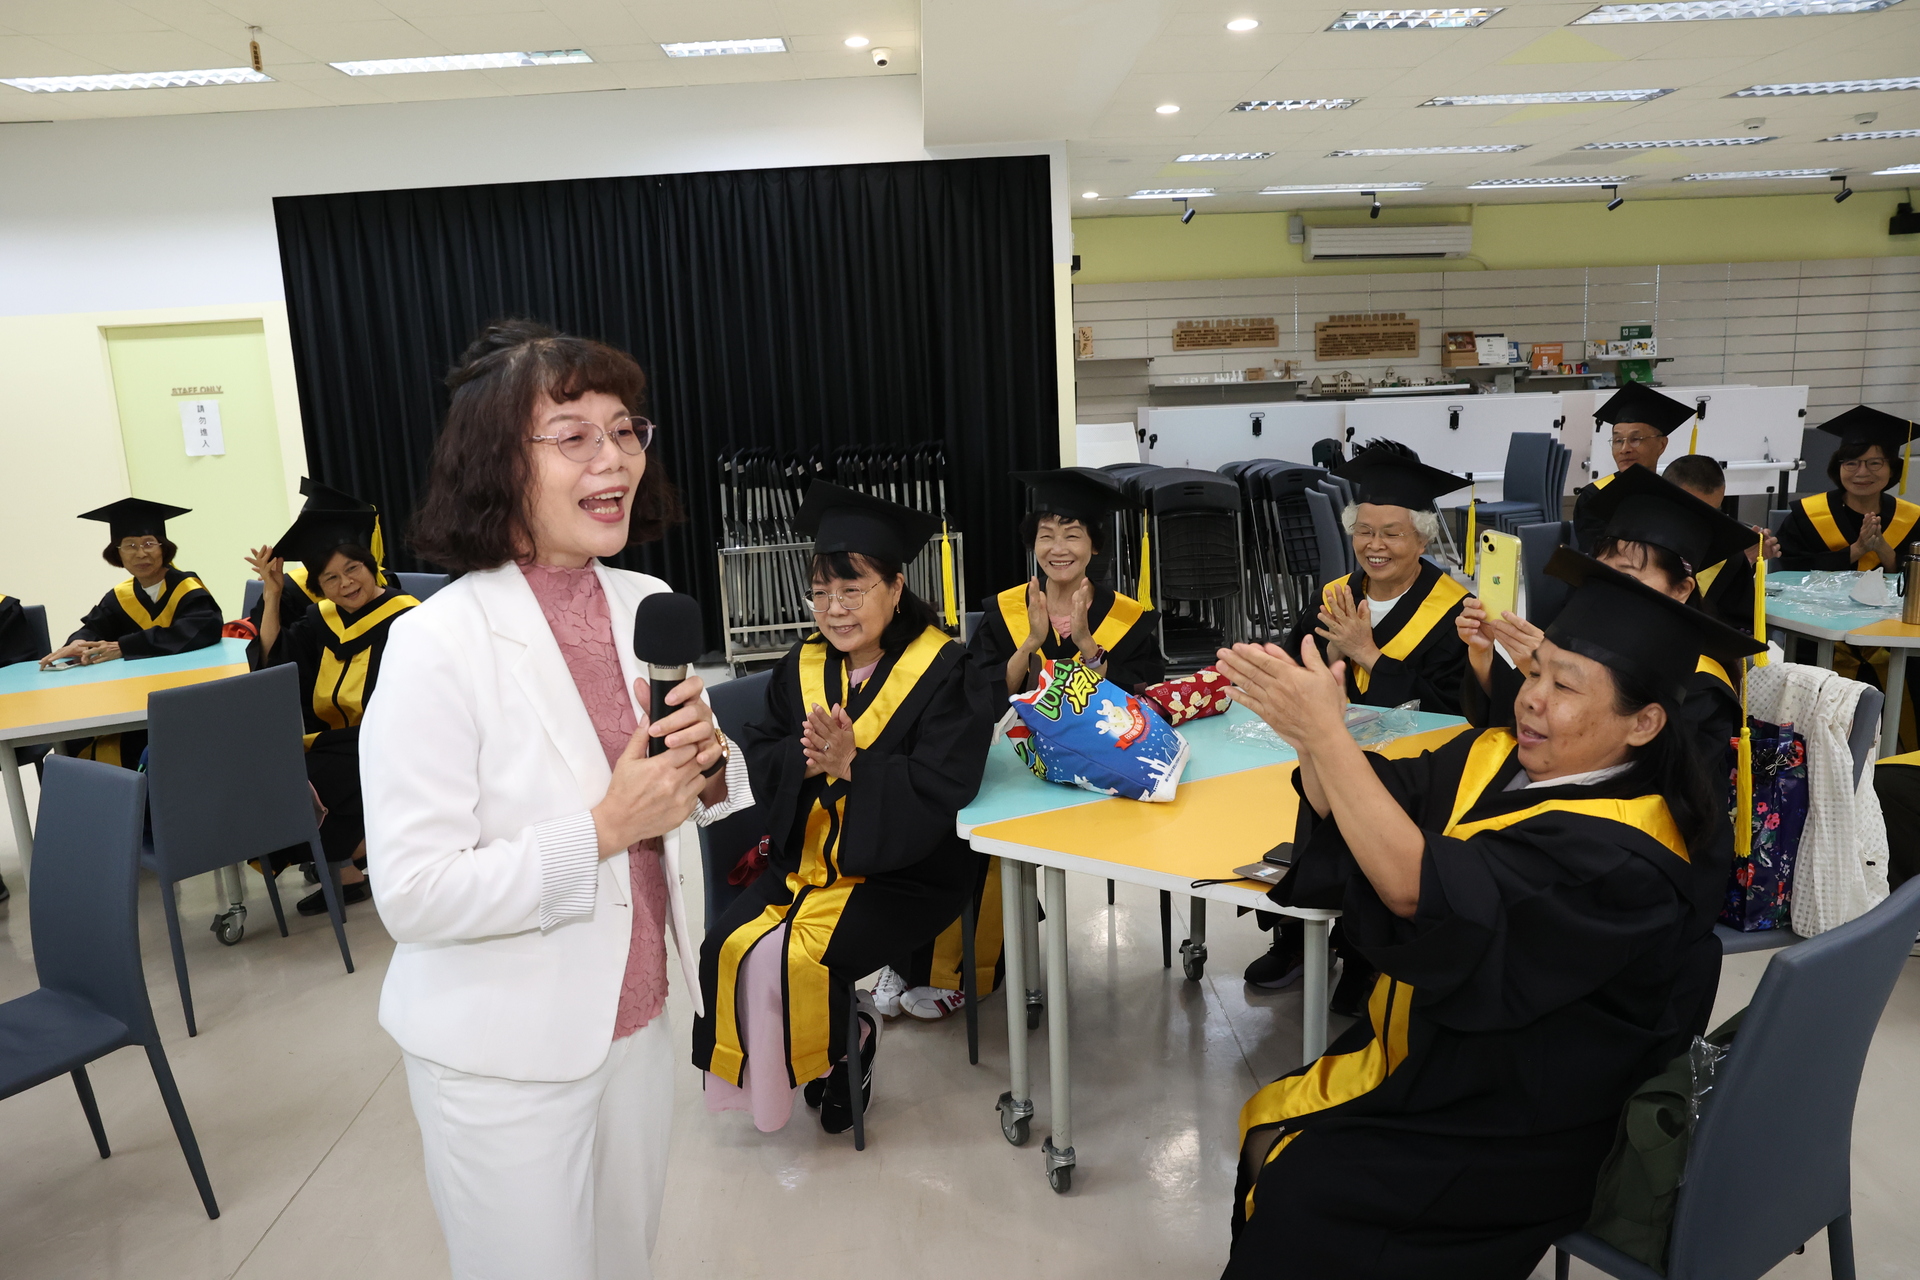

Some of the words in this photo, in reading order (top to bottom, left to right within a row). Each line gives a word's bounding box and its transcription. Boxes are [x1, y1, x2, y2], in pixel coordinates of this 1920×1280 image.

[1622, 328, 1629, 336] 13
[1534, 346, 1540, 354] 11
[171, 387, 197, 395] STAFF
[200, 385, 222, 393] ONLY
[197, 405, 210, 448] 請勿進入
[1035, 660, 1080, 720] LONEL
